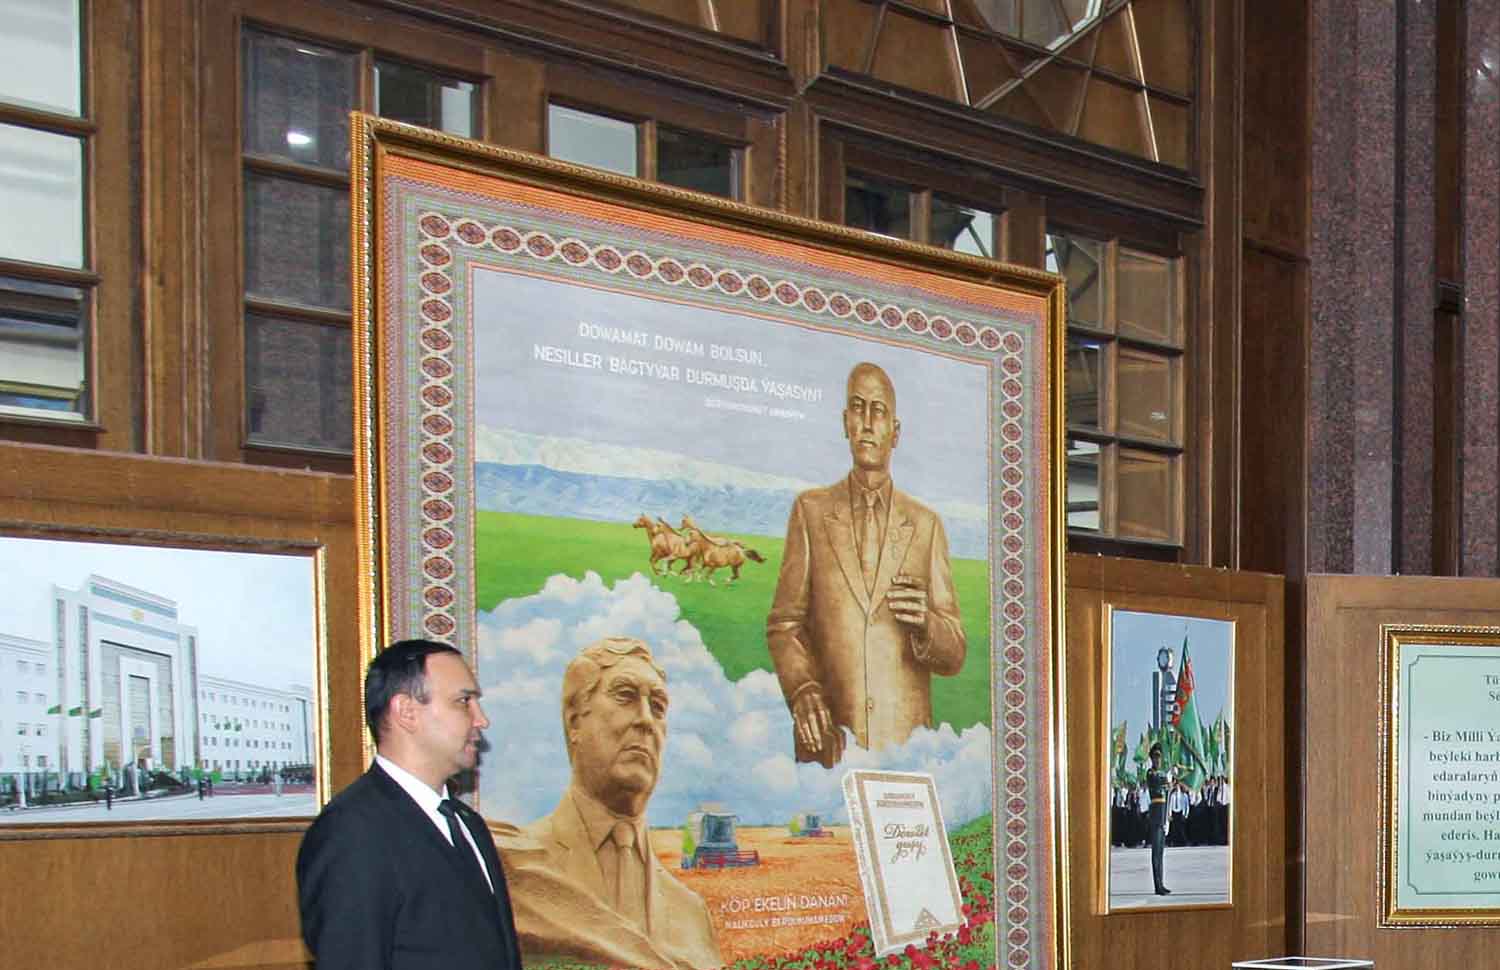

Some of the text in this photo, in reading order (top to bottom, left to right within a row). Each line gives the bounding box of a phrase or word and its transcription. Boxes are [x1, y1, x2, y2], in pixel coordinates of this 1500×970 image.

[1432, 731, 1452, 742] Biz
[1456, 731, 1484, 742] Milli
[1429, 750, 1472, 765] beýleki
[1427, 790, 1489, 805] binýadyny
[1423, 811, 1472, 821] mundan
[1441, 831, 1480, 841] ederis.
